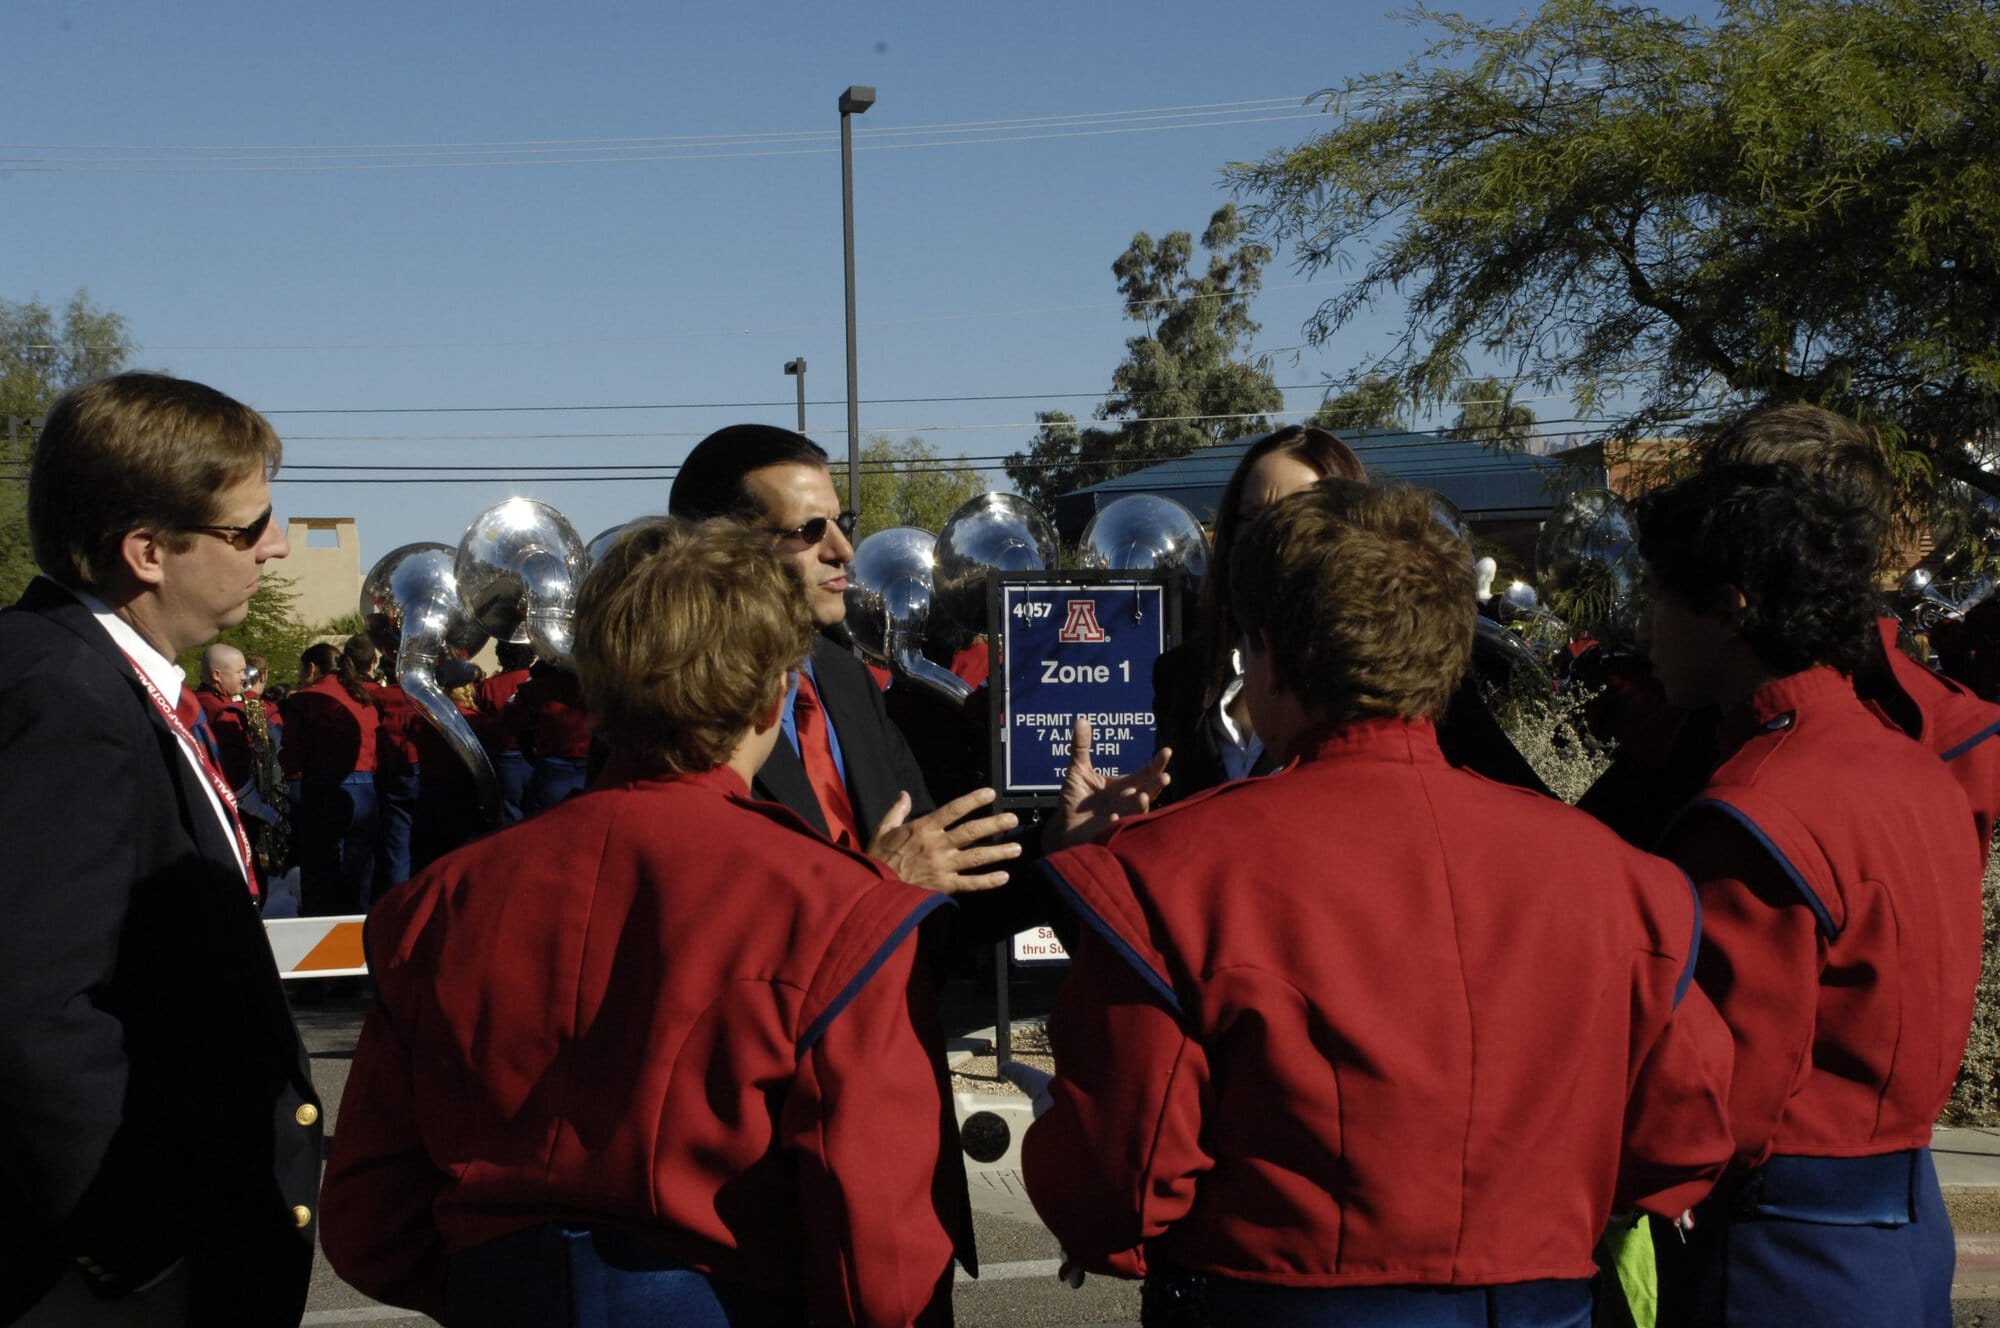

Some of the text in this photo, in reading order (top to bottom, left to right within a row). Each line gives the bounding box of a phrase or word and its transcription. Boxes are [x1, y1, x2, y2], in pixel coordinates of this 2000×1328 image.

[1013, 602, 1053, 619] 4057
[1059, 600, 1105, 643] A
[1041, 660, 1130, 684] Zone 1
[1016, 713, 1073, 727] PERMIT
[1037, 728, 1046, 741] 7
[1105, 727, 1134, 741] P.M.
[1093, 767, 1119, 777] ONE
[1022, 943, 1046, 955] thru
